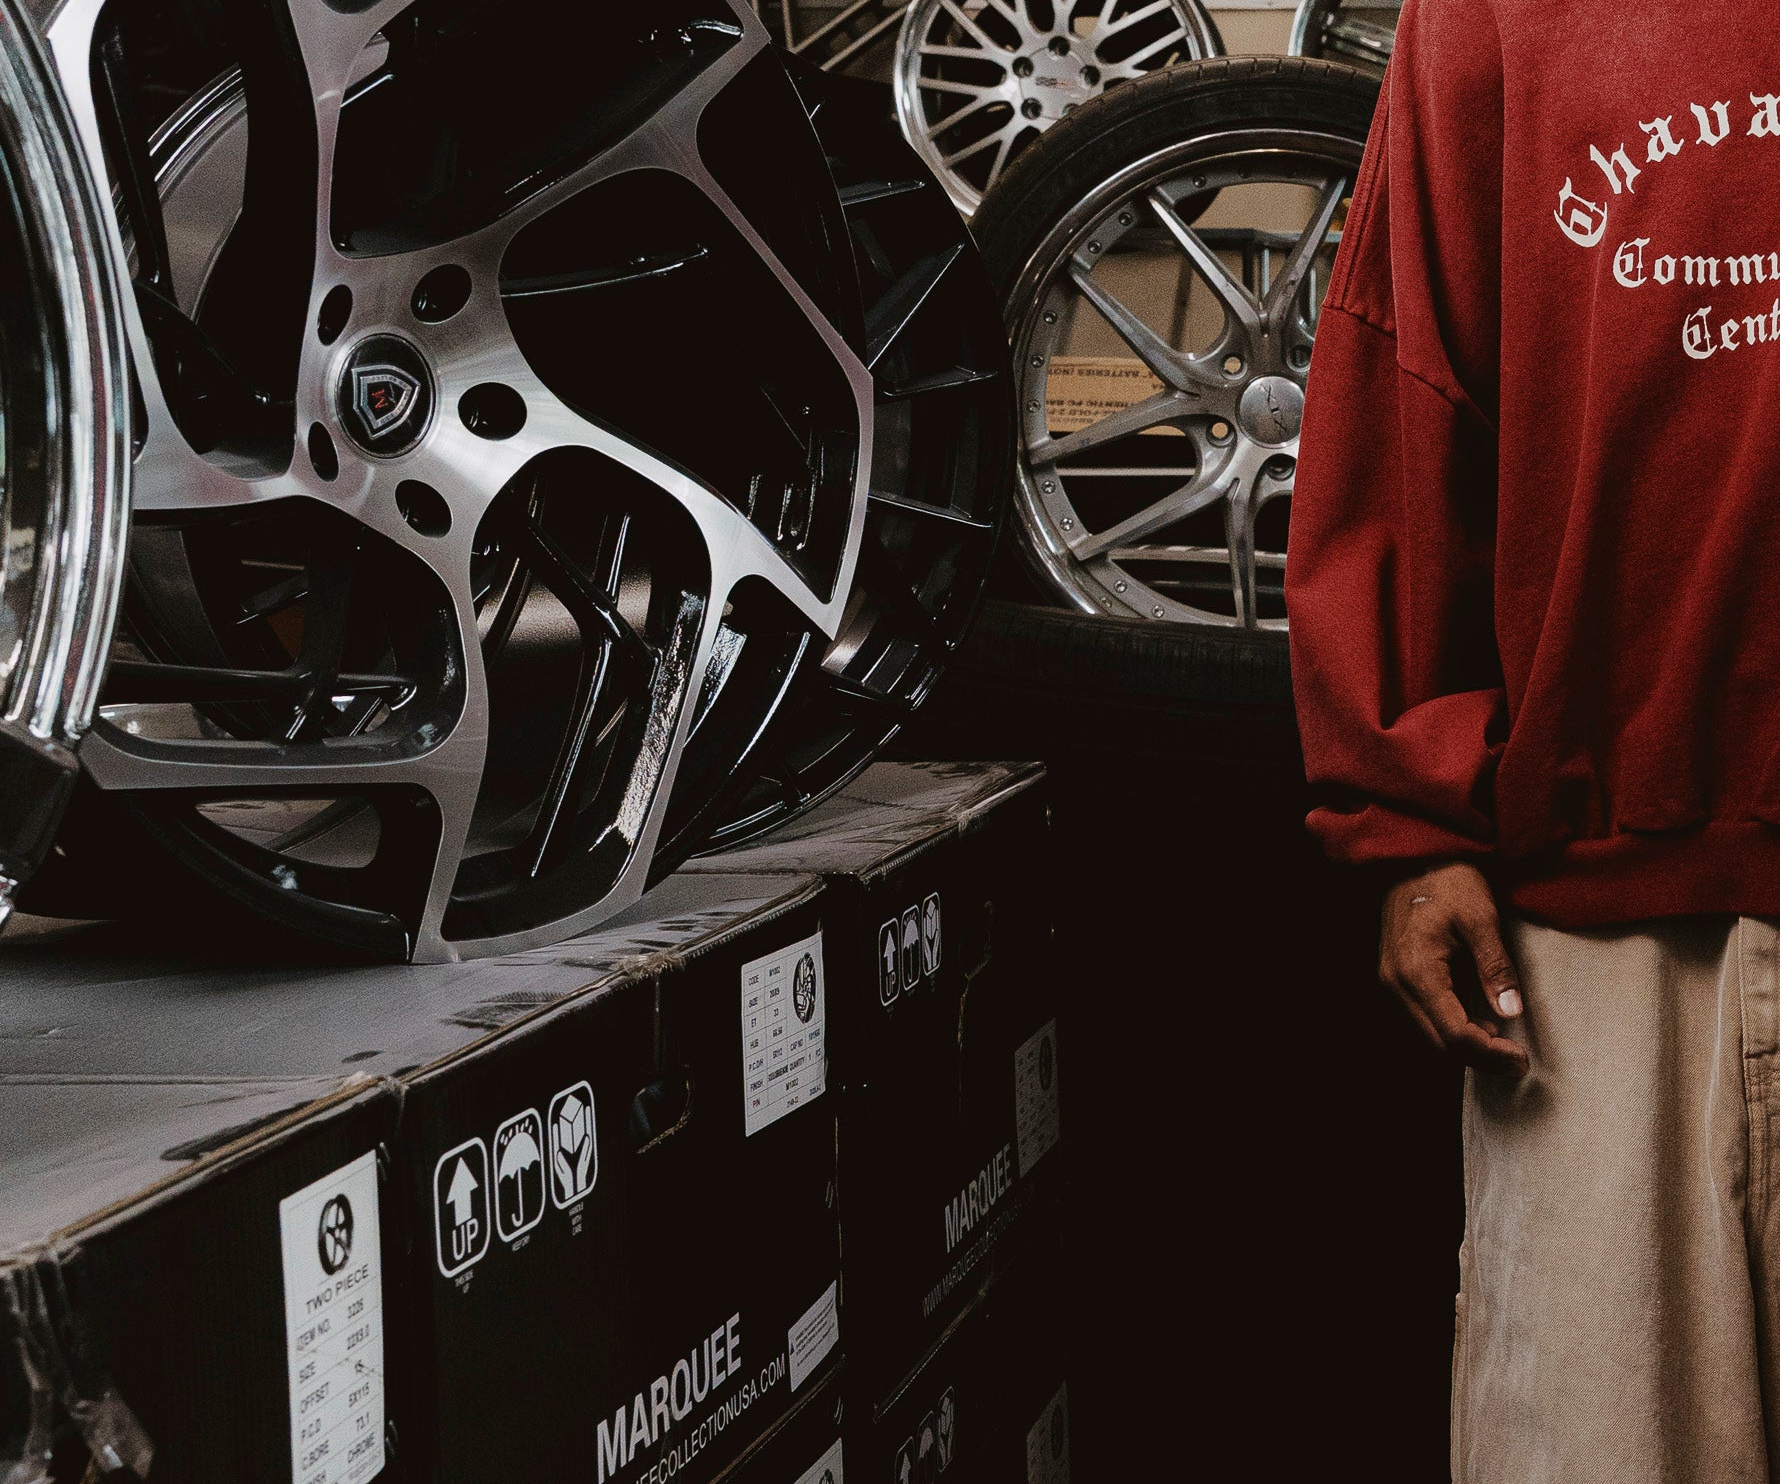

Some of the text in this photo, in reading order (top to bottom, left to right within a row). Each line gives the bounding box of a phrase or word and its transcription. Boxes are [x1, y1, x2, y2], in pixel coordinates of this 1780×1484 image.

[944, 1143, 1012, 1254] MARQUEE
[452, 1218, 479, 1261] UP
[306, 1263, 369, 1314] TWO PIECE
